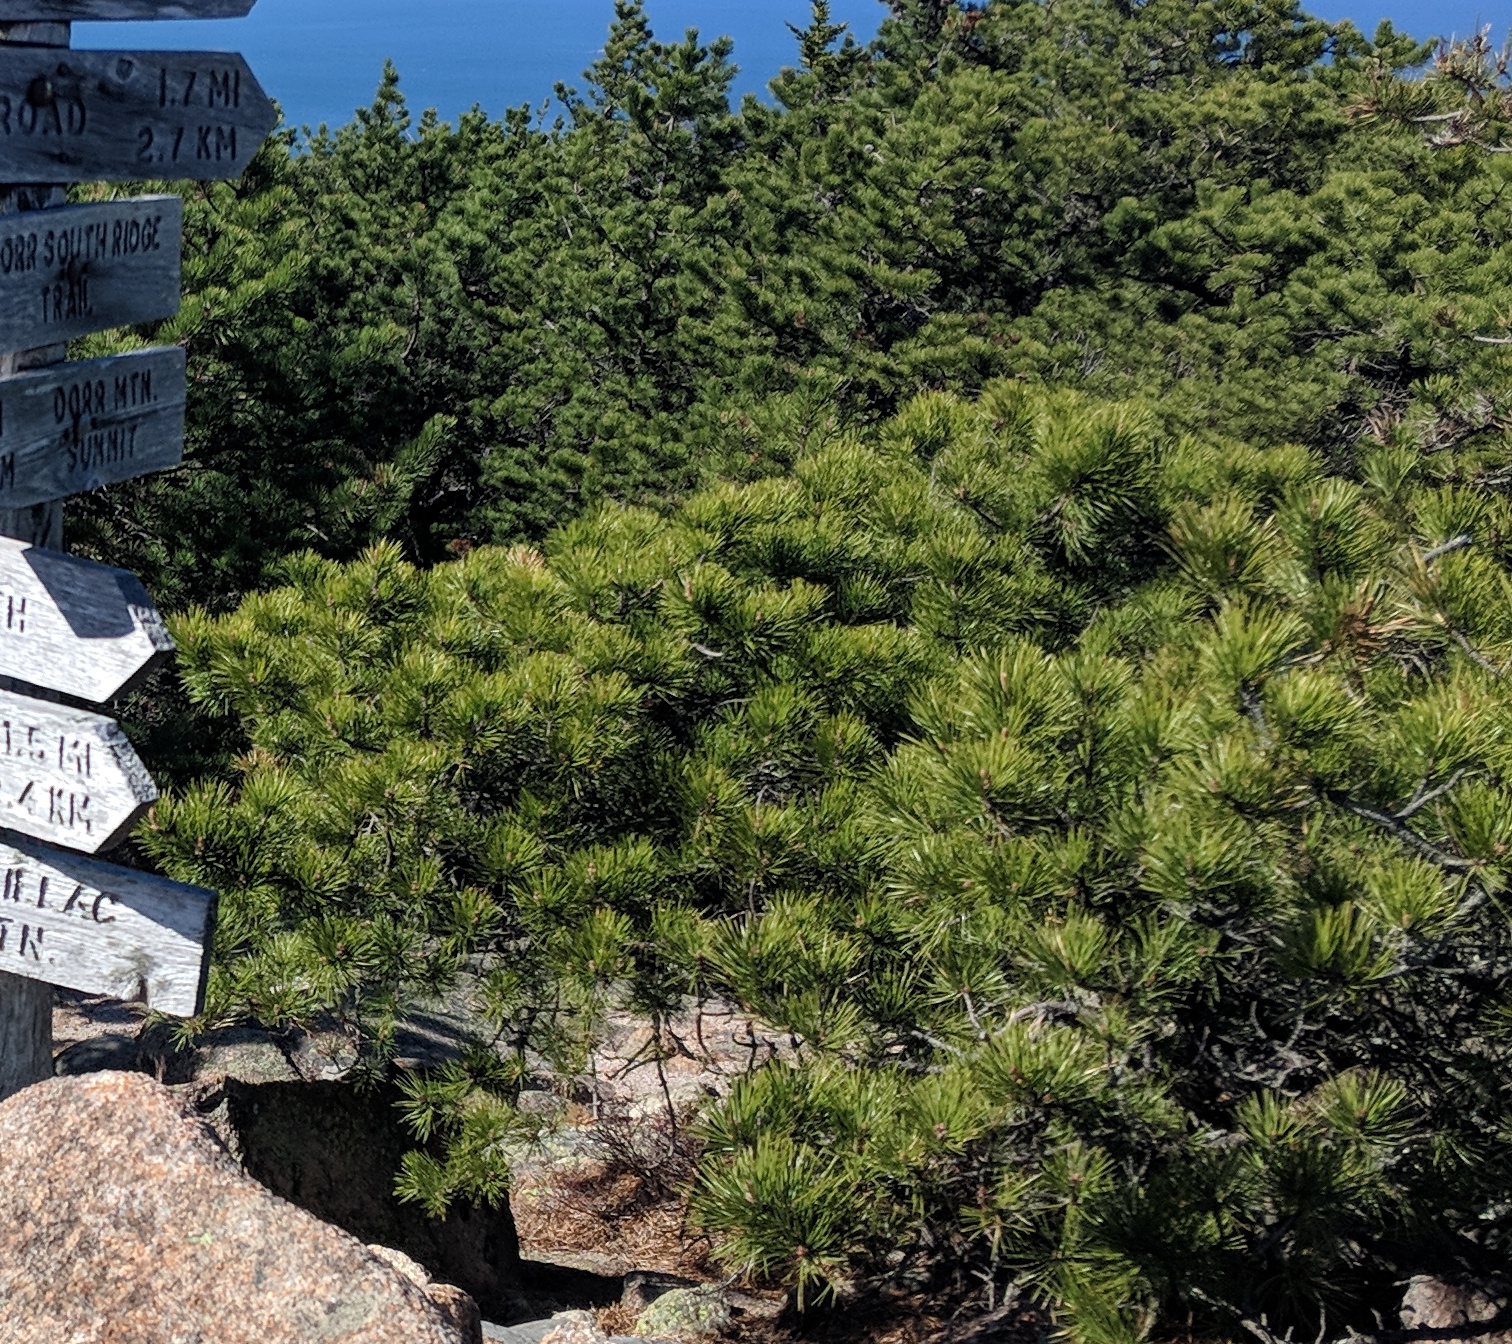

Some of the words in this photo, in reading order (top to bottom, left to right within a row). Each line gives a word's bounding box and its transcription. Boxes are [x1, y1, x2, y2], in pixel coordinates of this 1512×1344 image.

[158, 67, 197, 107] 1.7
[209, 68, 240, 108] MI
[138, 125, 185, 162] 2.7
[196, 125, 238, 162] KM
[43, 221, 107, 267] SOUTH
[112, 214, 162, 257] RIDGE
[42, 278, 94, 323] TRAIL
[54, 379, 105, 424] DORR
[114, 368, 158, 410] MTN.
[67, 424, 138, 473] SUMMIT
[58, 735, 91, 778] MI
[49, 785, 93, 833] KM
